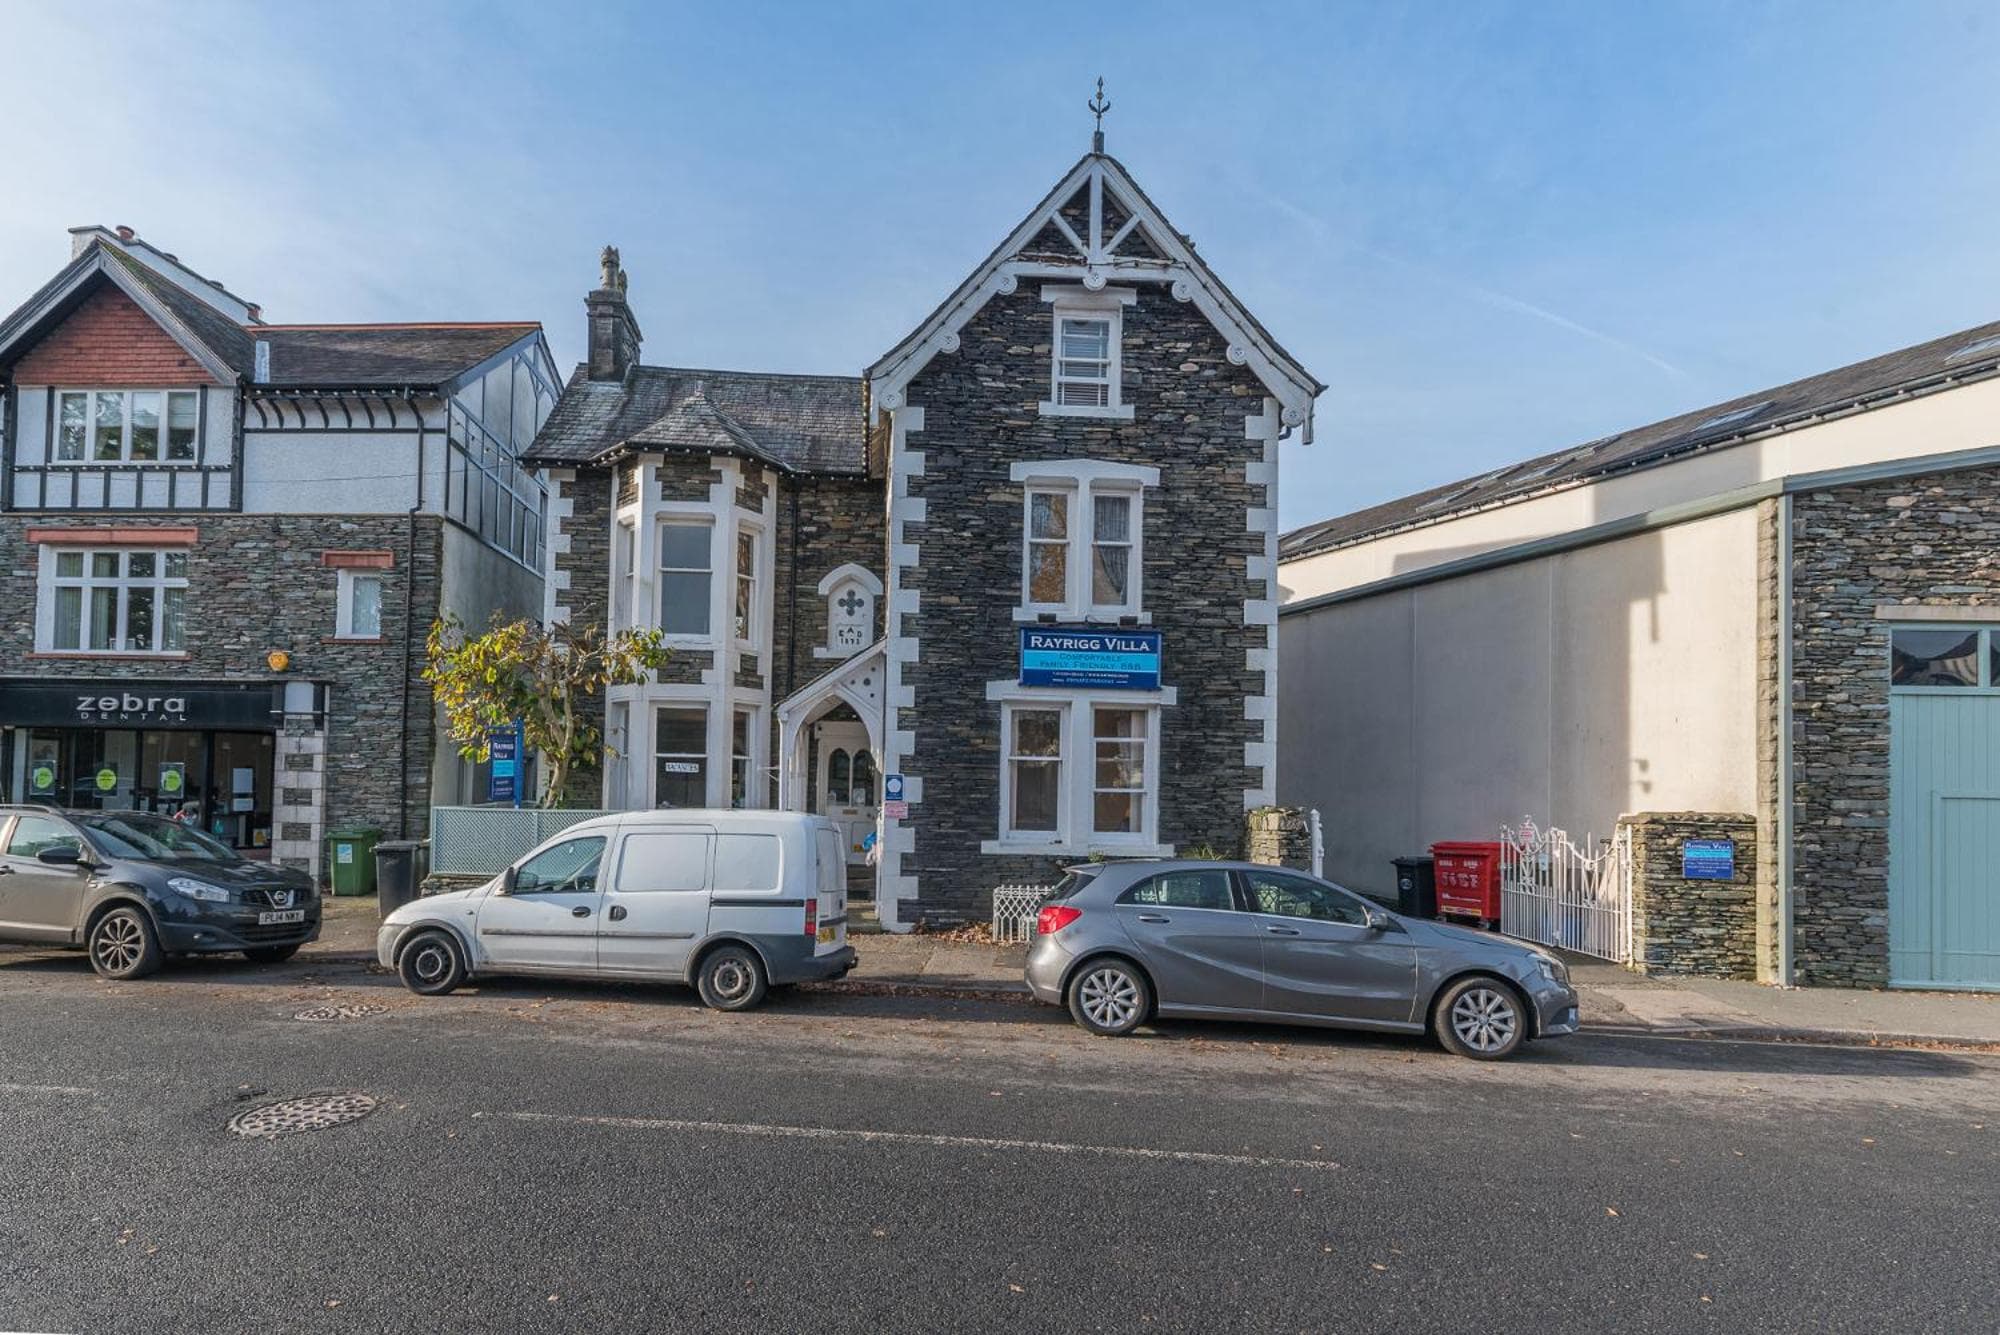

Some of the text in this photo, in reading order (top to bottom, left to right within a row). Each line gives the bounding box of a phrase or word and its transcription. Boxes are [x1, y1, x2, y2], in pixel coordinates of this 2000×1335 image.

[1030, 635, 1150, 651] RAYRIGG VILLA
[1059, 652, 1121, 663] COMFORTABLE
[1040, 661, 1069, 669] FAMILY
[1073, 661, 1117, 670] FRIENDLY
[76, 692, 185, 712] zebra
[81, 712, 186, 721] DENTAL
